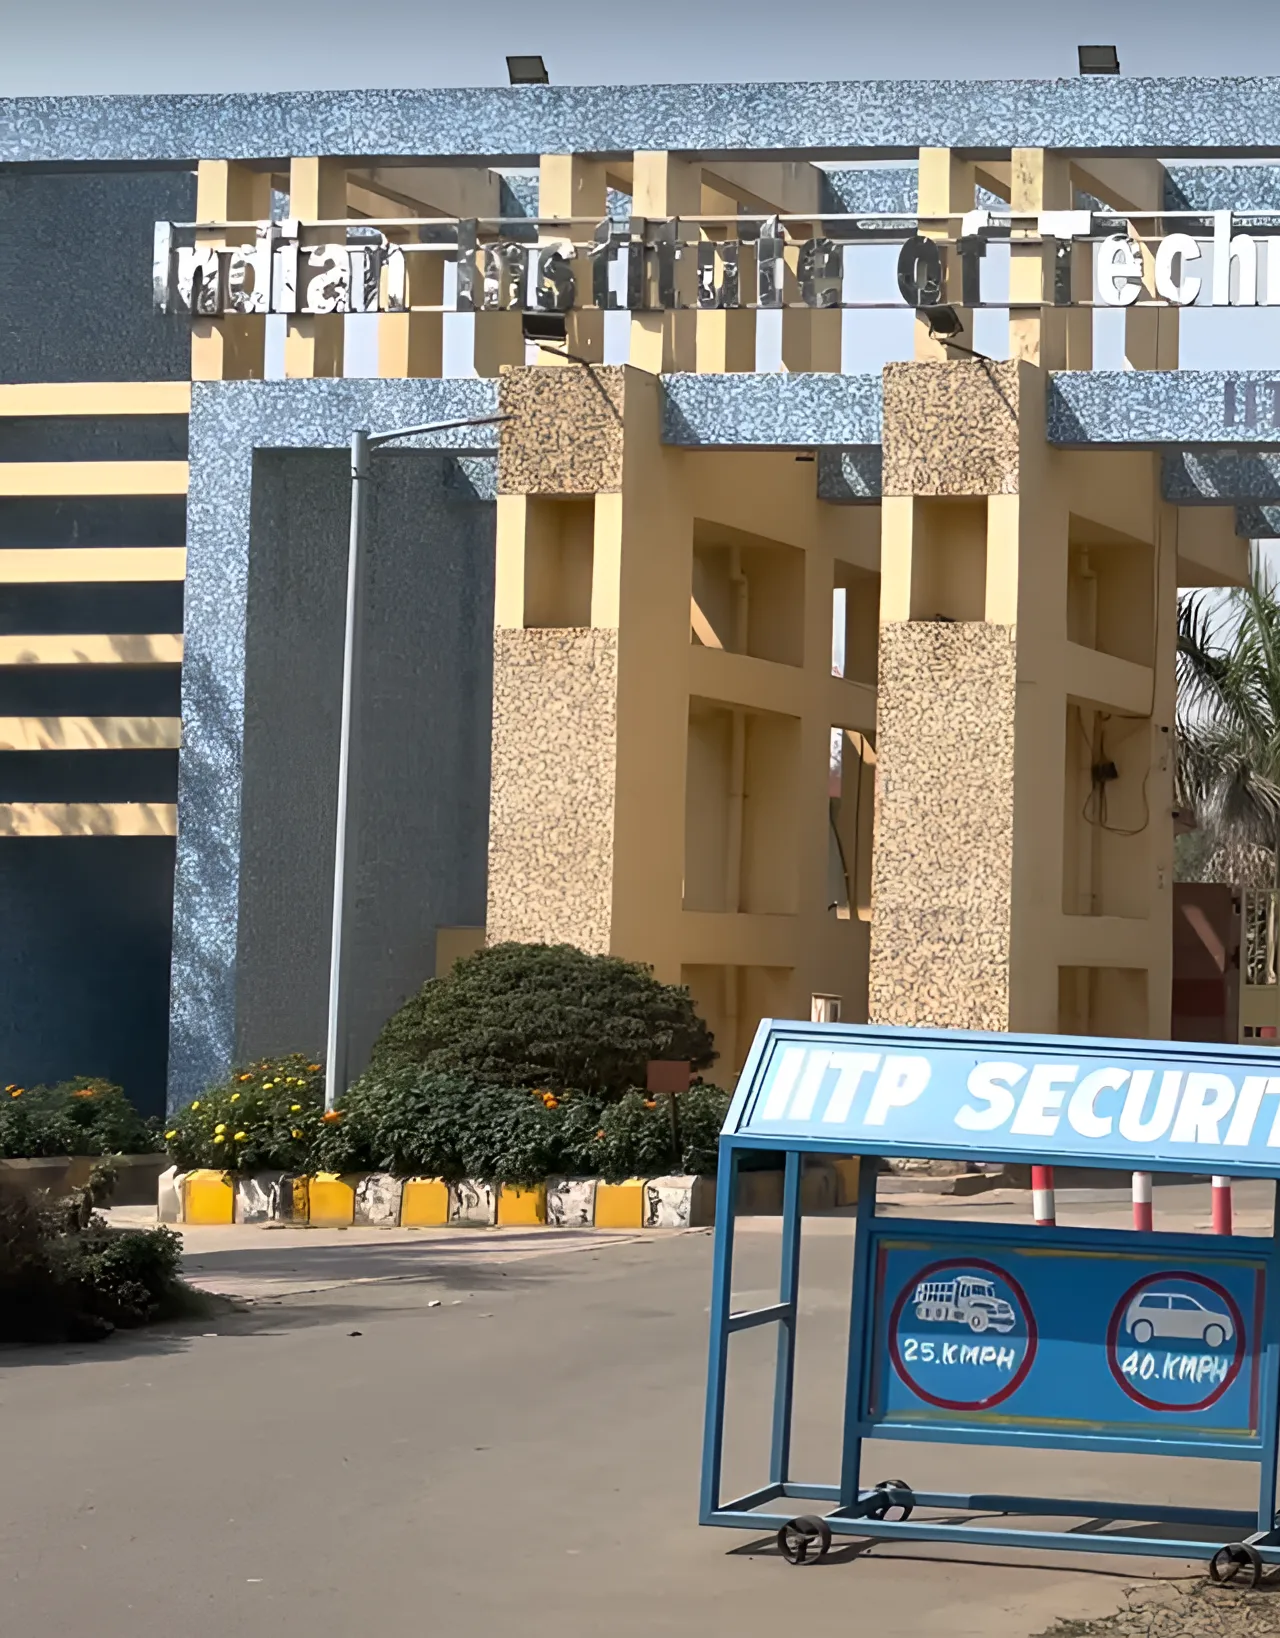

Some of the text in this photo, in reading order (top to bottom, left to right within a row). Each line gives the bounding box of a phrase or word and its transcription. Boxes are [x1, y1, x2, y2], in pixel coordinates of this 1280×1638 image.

[154, 219, 409, 314] Indian
[457, 214, 845, 311] Institute
[896, 210, 991, 306] of
[761, 1046, 932, 1127] IITP
